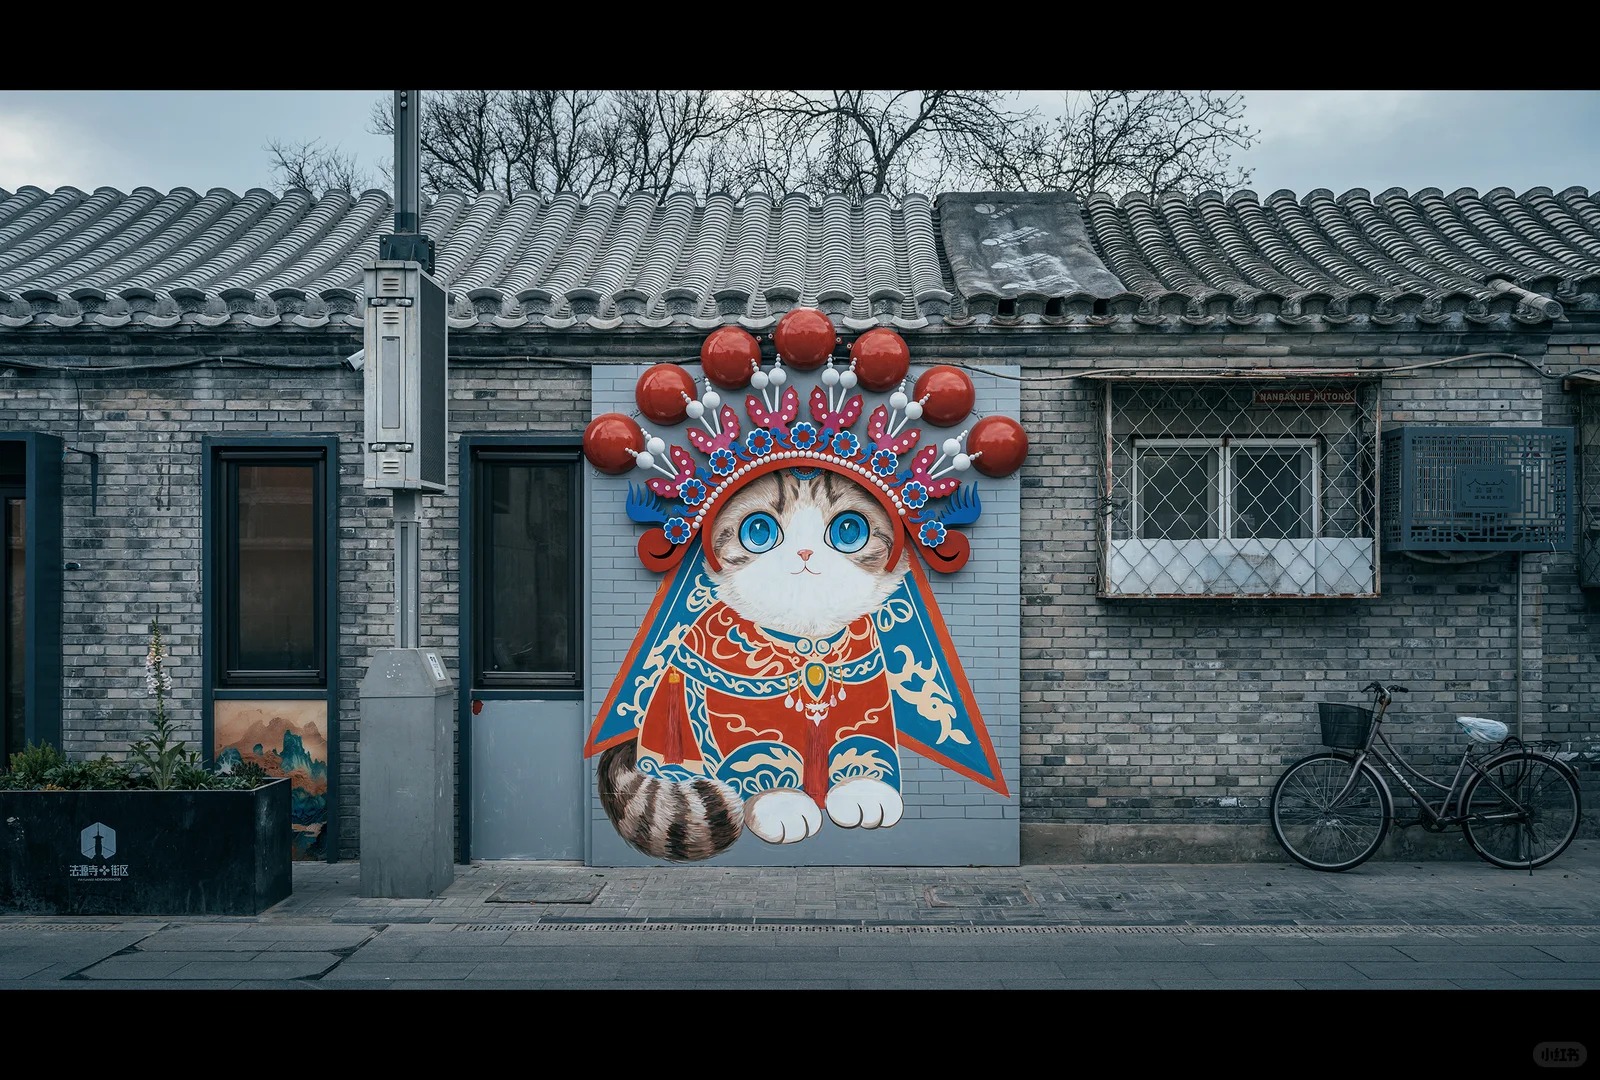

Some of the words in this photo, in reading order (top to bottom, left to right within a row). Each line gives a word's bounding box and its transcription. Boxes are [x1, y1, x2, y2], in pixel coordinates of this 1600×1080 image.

[1260, 392, 1310, 401] NANBANJIE
[1314, 392, 1351, 401] HUTONG
[69, 864, 98, 877] 法源寺
[110, 864, 129, 877] 街区
